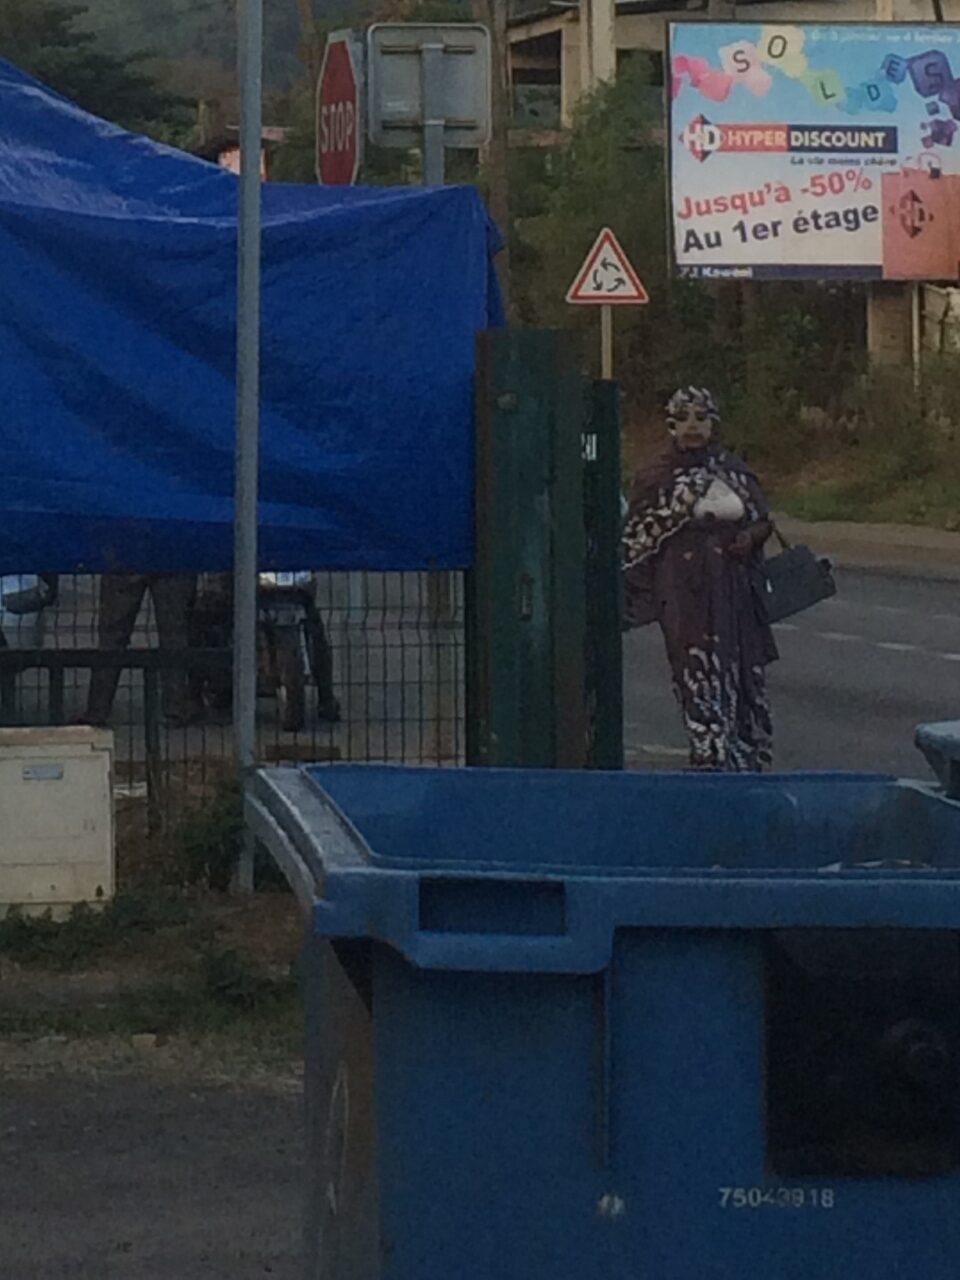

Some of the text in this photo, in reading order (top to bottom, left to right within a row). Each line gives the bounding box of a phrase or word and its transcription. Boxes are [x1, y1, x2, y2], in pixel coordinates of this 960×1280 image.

[321, 100, 354, 154] STOP
[677, 168, 873, 220] Jusqu'à -50%
[683, 204, 880, 254] Au 1er étage
